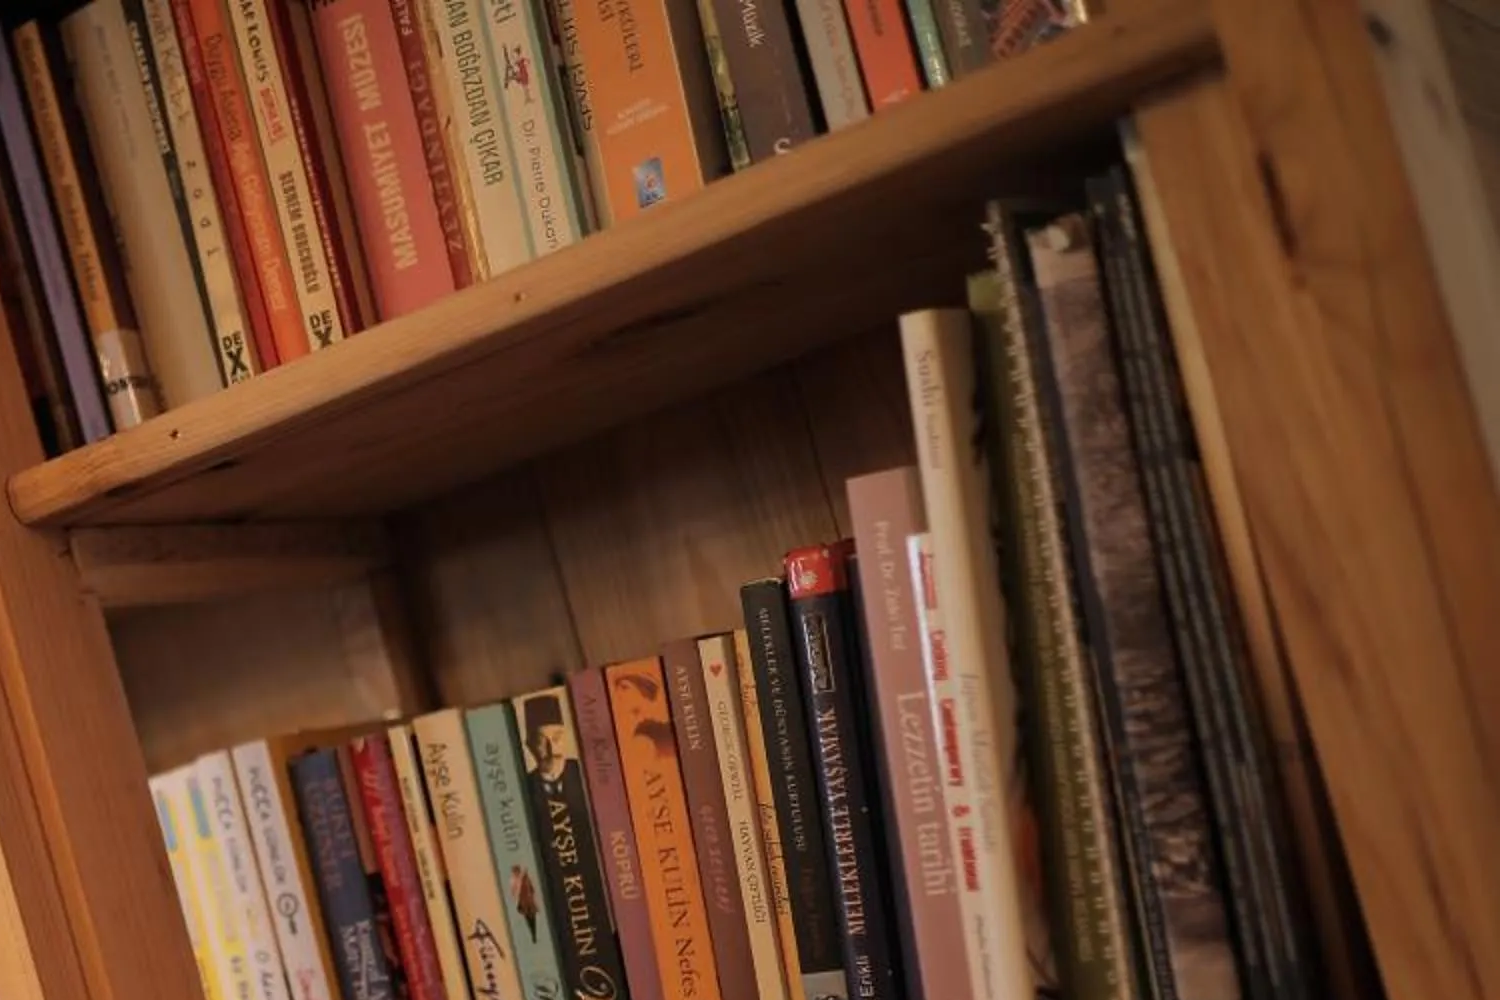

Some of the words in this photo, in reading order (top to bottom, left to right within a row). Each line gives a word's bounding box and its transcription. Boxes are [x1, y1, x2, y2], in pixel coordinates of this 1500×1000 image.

[336, 11, 384, 112] MÜZESİ
[449, 28, 495, 126] BOĞAZDAN
[359, 118, 421, 270] MASUMİYET
[405, 58, 465, 254] ZEYTİNDAĞI
[468, 128, 506, 187] ÇIKAR
[424, 739, 457, 787] Ayşe
[815, 705, 852, 803] YAŞAMAK
[893, 689, 944, 814] Lezzetin
[438, 790, 470, 839] Kulin
[481, 741, 509, 796] ayşe
[496, 799, 523, 852] kulin
[542, 796, 580, 869] AYŞE
[952, 803, 970, 817] &
[608, 828, 641, 902] KÖPRÜ
[736, 819, 757, 872] HAYVAN
[829, 805, 867, 937] MELEKLERLE
[914, 819, 955, 898] tarihi
[560, 873, 601, 957] KULİN
[655, 844, 696, 929] KULİN
[670, 935, 704, 1000] Nefes
[854, 954, 875, 999] Erikli
